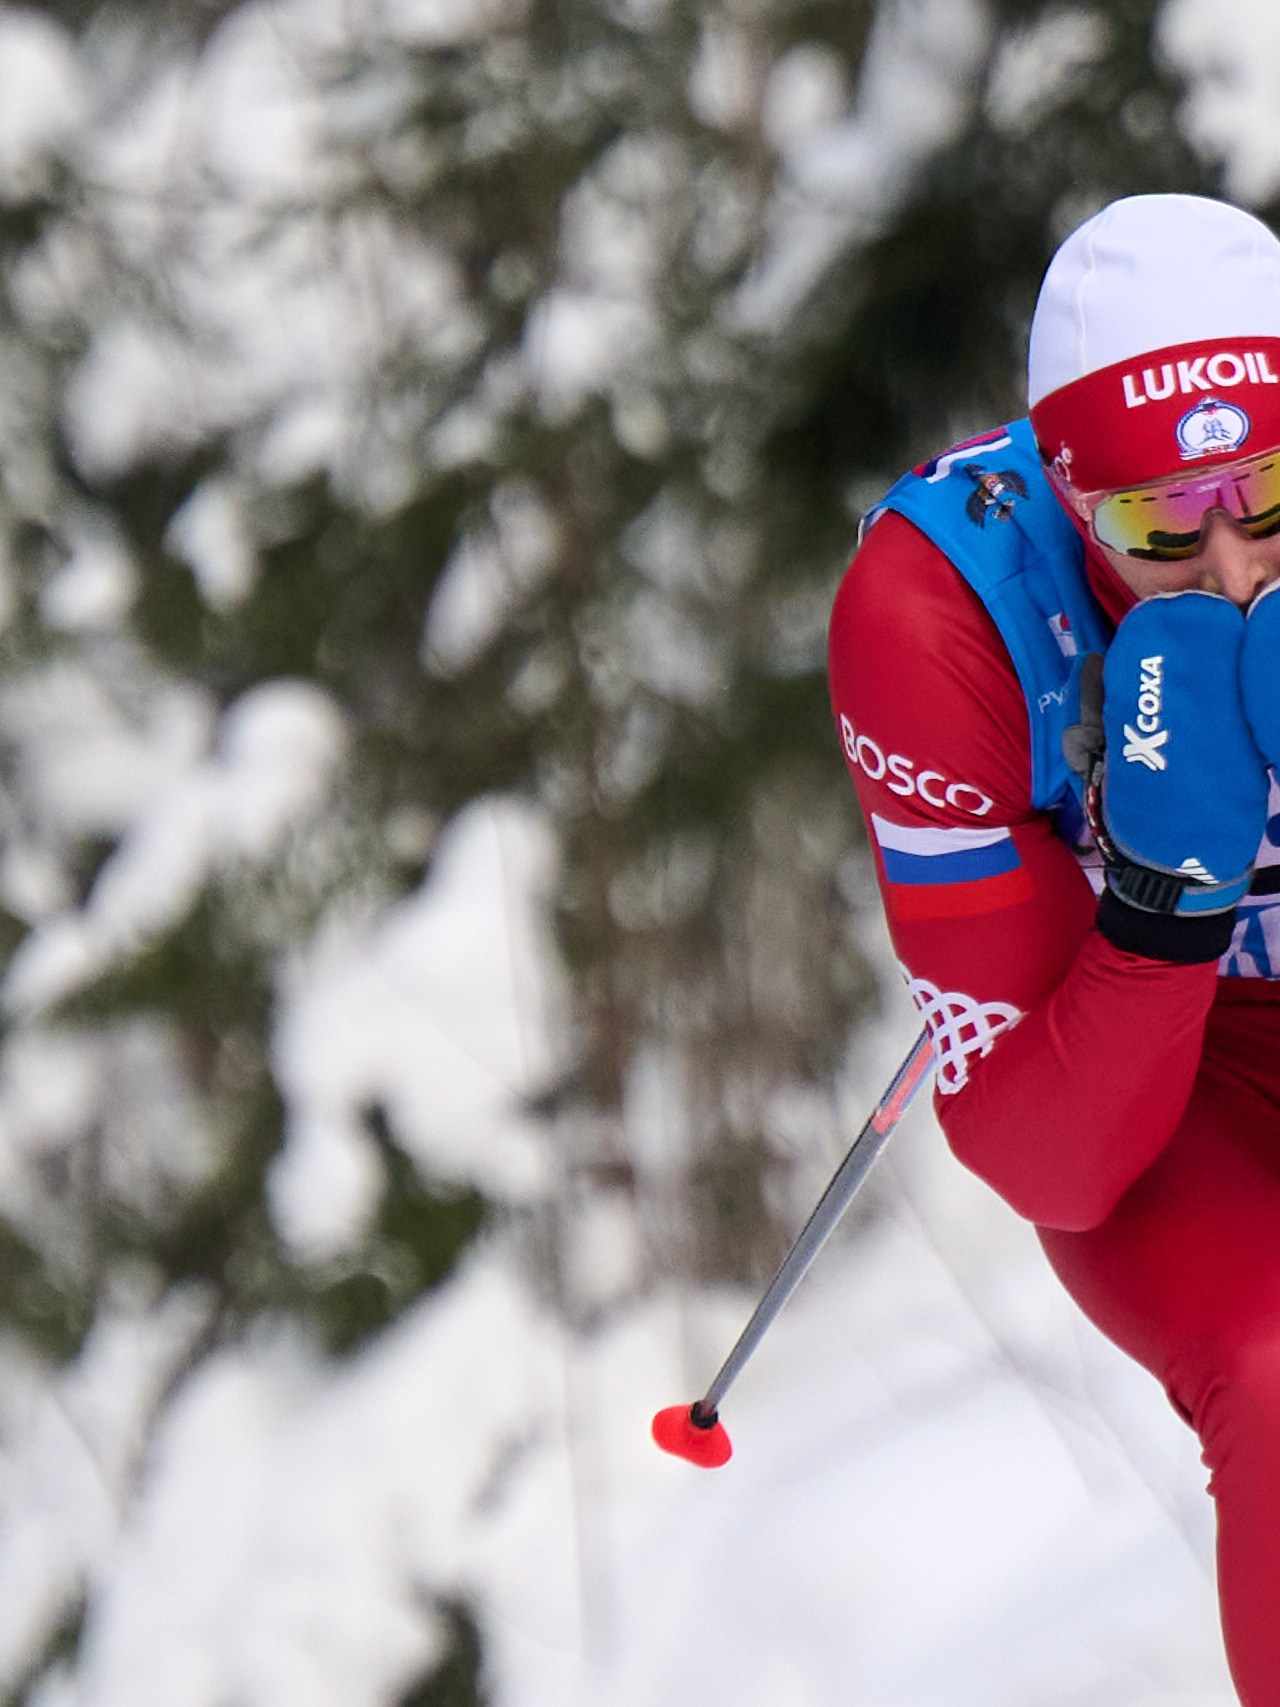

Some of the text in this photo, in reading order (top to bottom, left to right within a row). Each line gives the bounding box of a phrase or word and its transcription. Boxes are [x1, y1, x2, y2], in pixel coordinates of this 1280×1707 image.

[1122, 352, 1279, 408] LUKOIL
[1136, 655, 1163, 732] COXA
[840, 713, 994, 817] BOSCO
